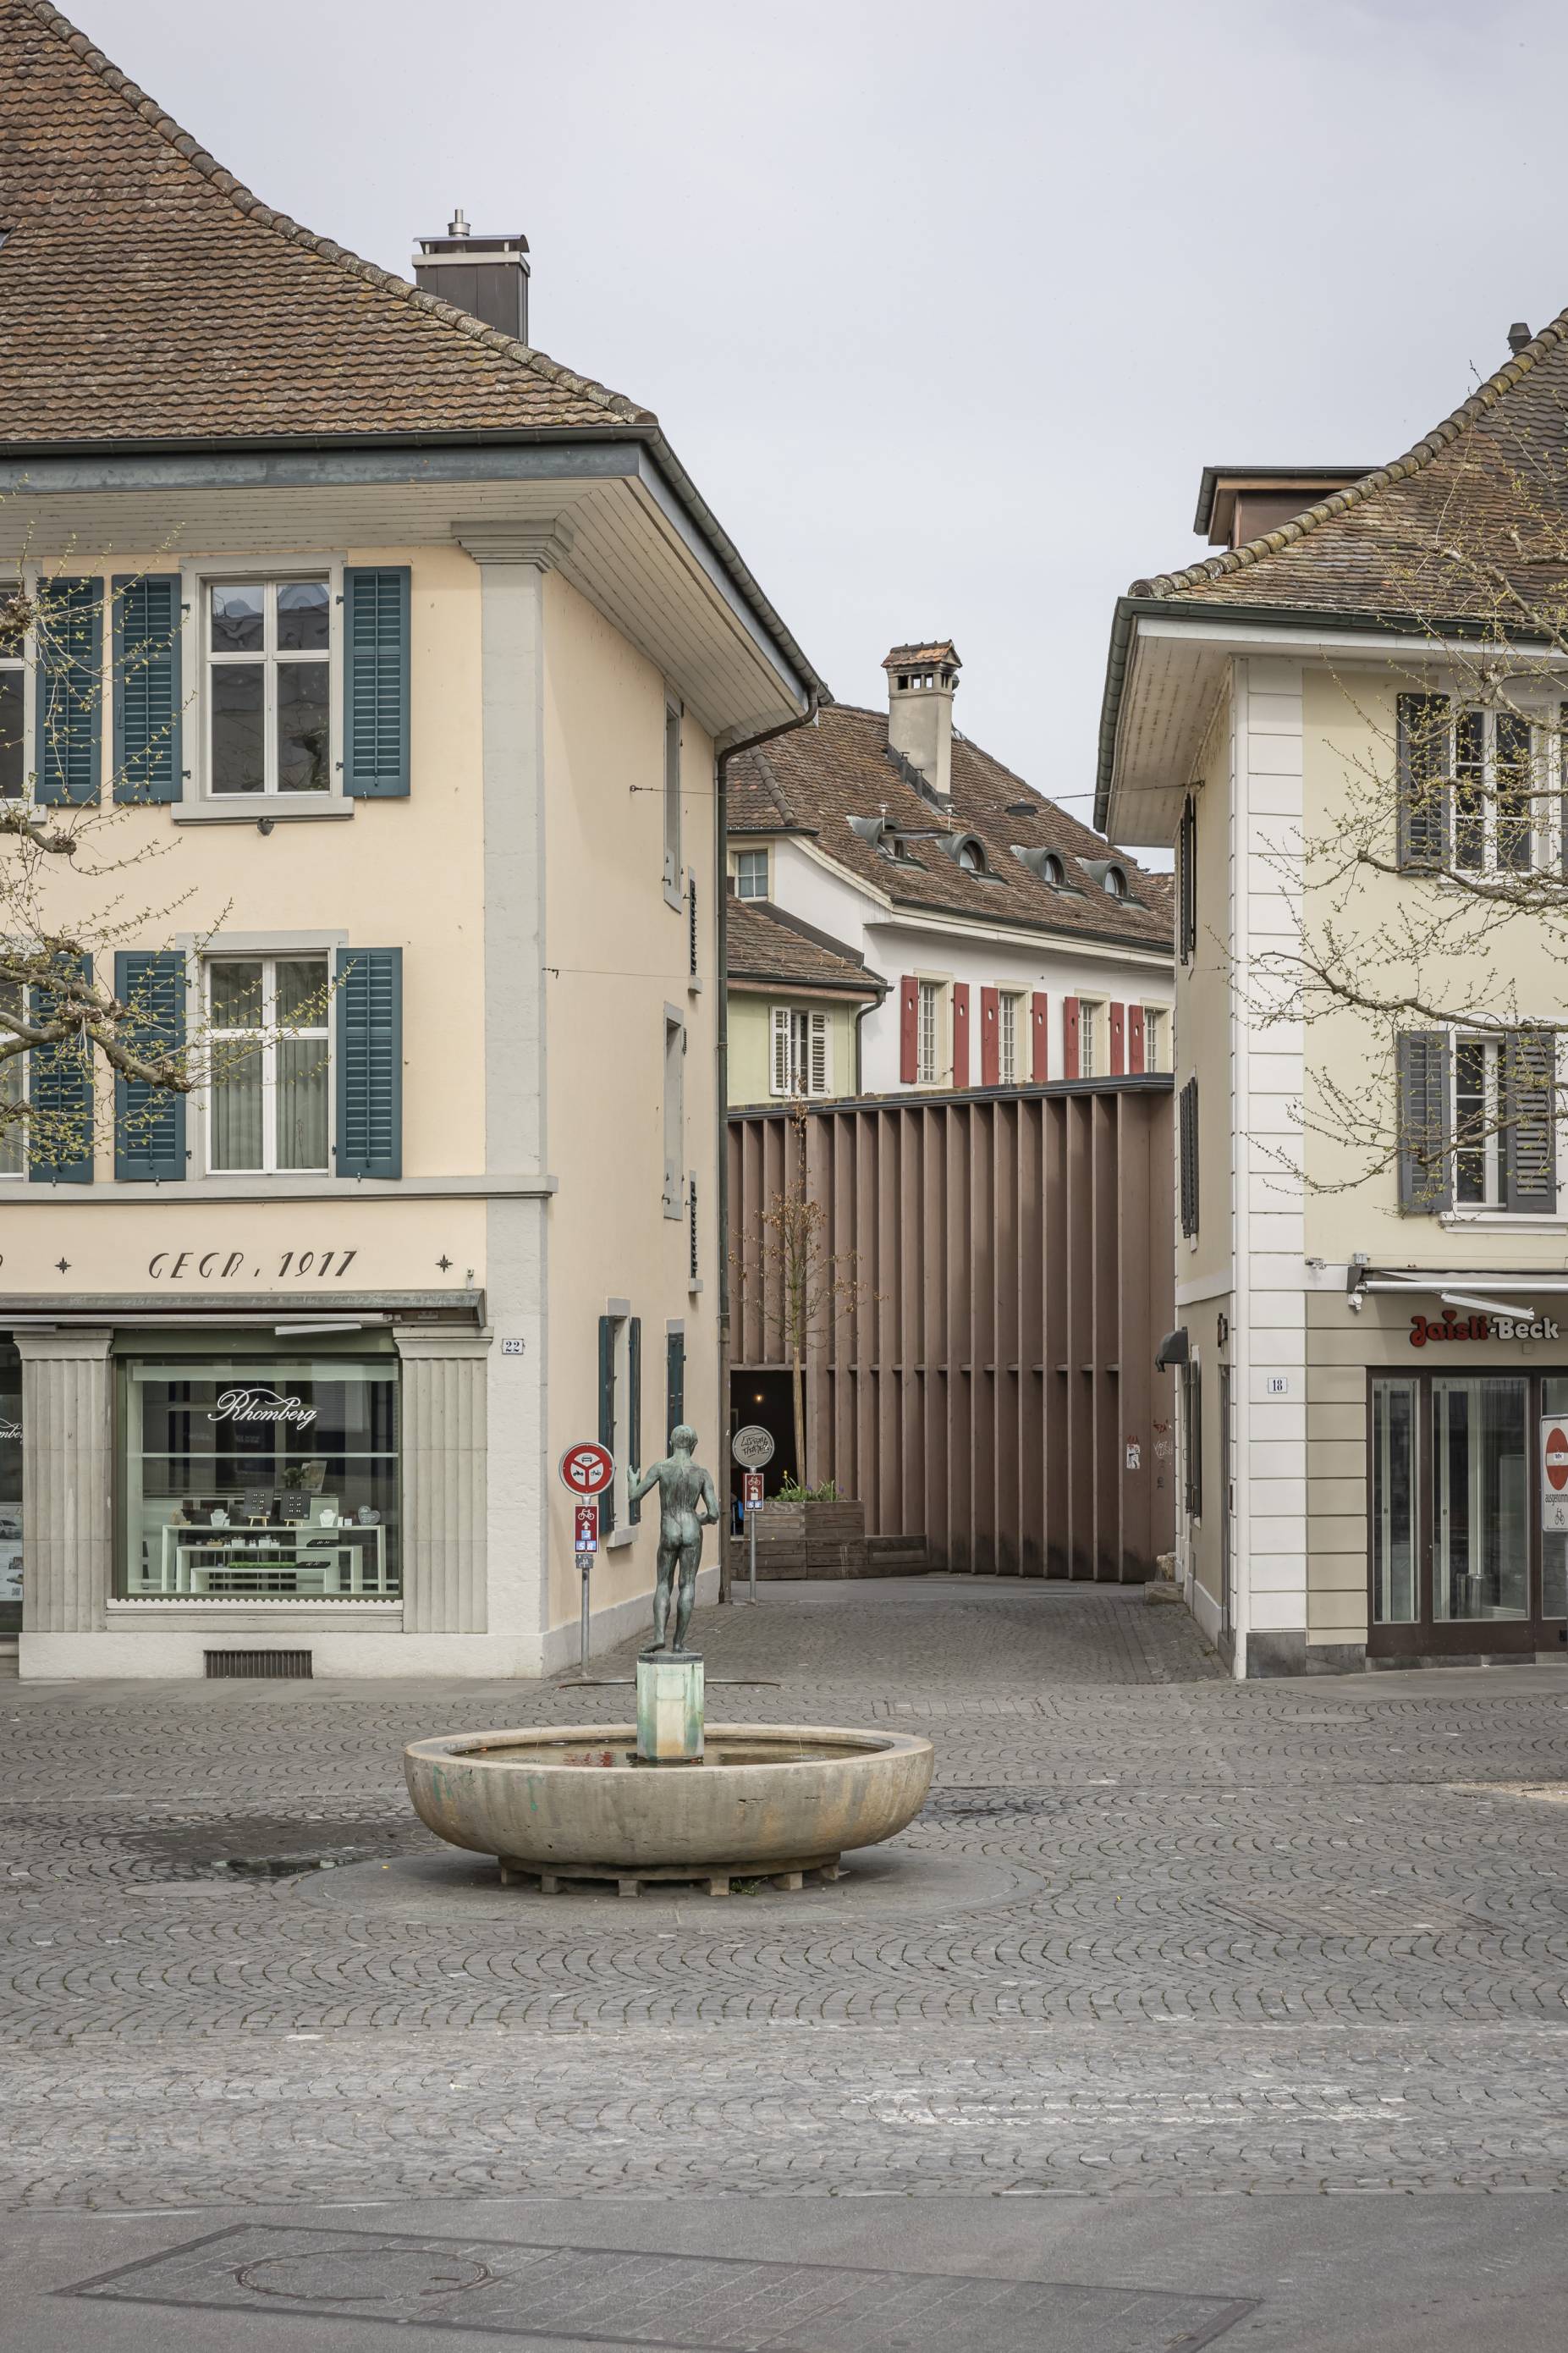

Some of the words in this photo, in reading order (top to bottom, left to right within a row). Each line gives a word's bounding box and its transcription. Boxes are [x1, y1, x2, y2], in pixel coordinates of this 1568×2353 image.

[278, 1250, 358, 1277] 1917
[1410, 1310, 1560, 1347] Jaisli-Beck
[505, 1341, 520, 1353] 22
[1273, 1379, 1283, 1391] 18
[207, 1388, 318, 1430] Rhomberg
